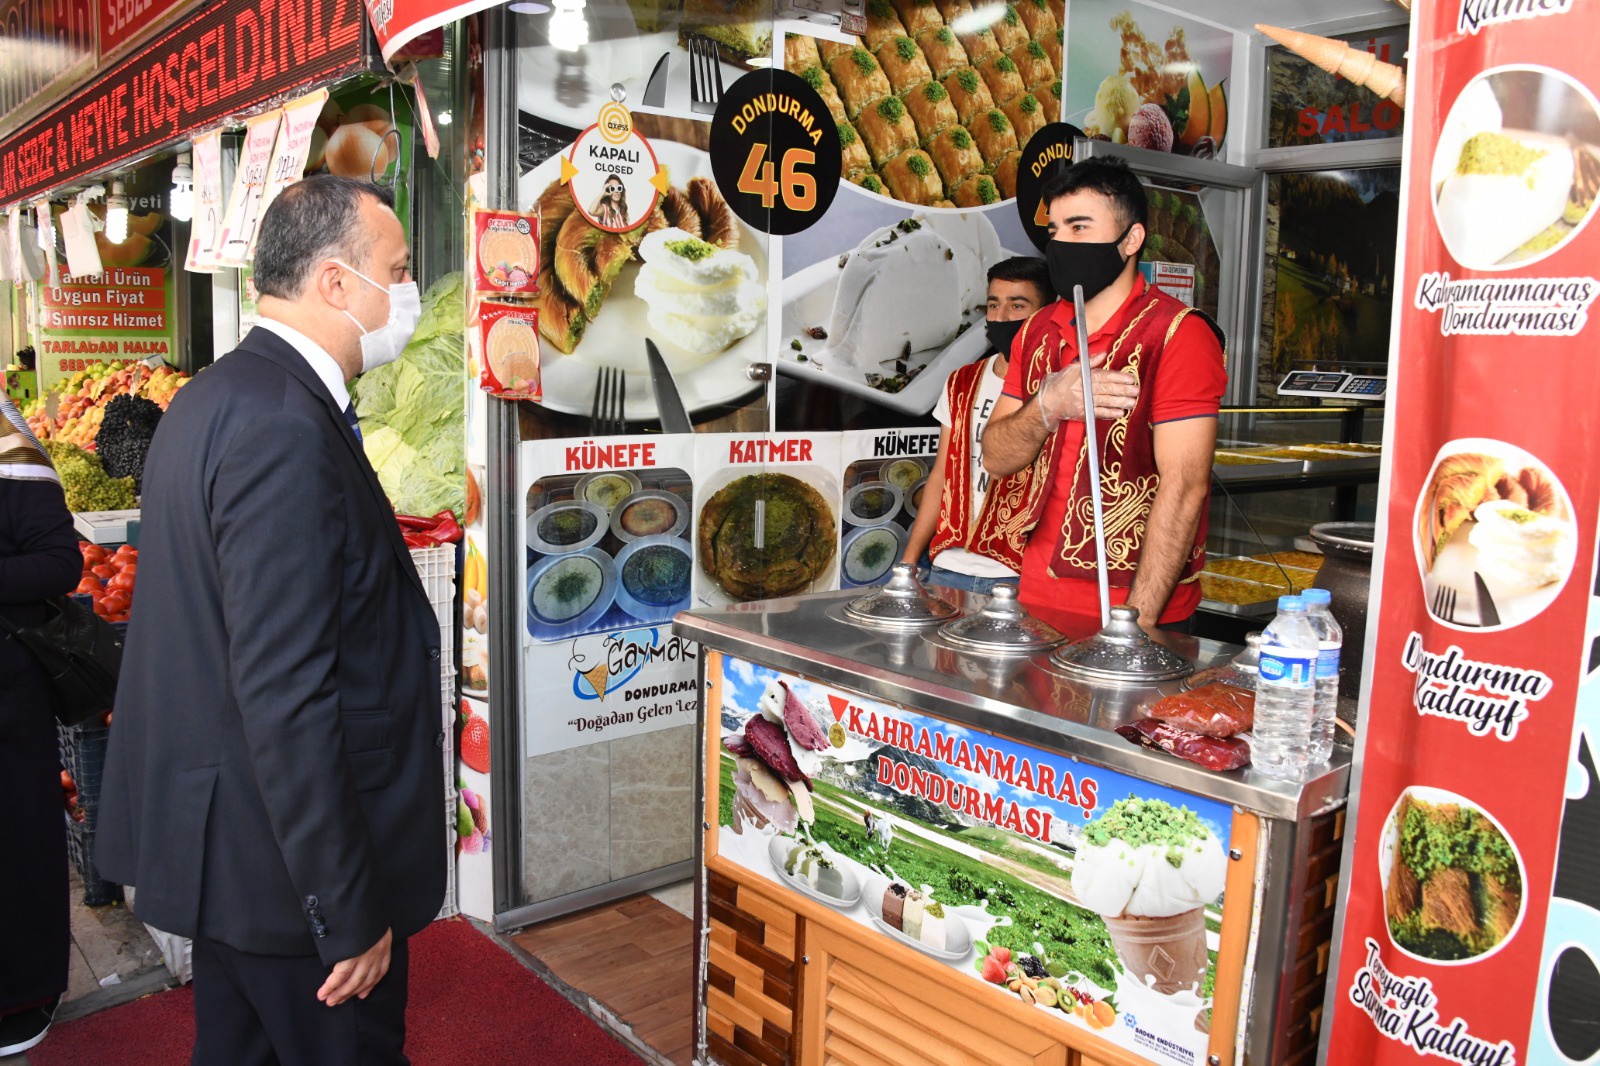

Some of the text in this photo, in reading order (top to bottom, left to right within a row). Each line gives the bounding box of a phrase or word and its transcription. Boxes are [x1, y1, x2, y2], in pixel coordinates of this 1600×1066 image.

[607, 121, 629, 132] axess
[731, 93, 823, 146] DONDURMA
[18, 128, 54, 190] SEBZE
[57, 121, 69, 172] &
[70, 83, 129, 166] MEYVE
[589, 144, 640, 163] KAPALI
[595, 162, 634, 175] CLOSED
[737, 142, 817, 211] 46
[114, 268, 151, 286] Ürün
[51, 289, 145, 306] Uygun Fiyat
[53, 311, 163, 327] Sınırsız Hizmet
[43, 340, 169, 354] TARLADAN HALKA
[565, 440, 656, 471] KÜNEFE
[729, 439, 813, 463] KATMER
[874, 431, 940, 457] KÜNEFE
[1405, 635, 1548, 696] Dondurma
[624, 679, 698, 702] DONDURMA
[638, 703, 673, 724] Gelen
[848, 705, 1098, 820] KAHRAMANMARAŞ
[877, 755, 1053, 844] DONDURMASI
[1352, 971, 1404, 1035] Sarma
